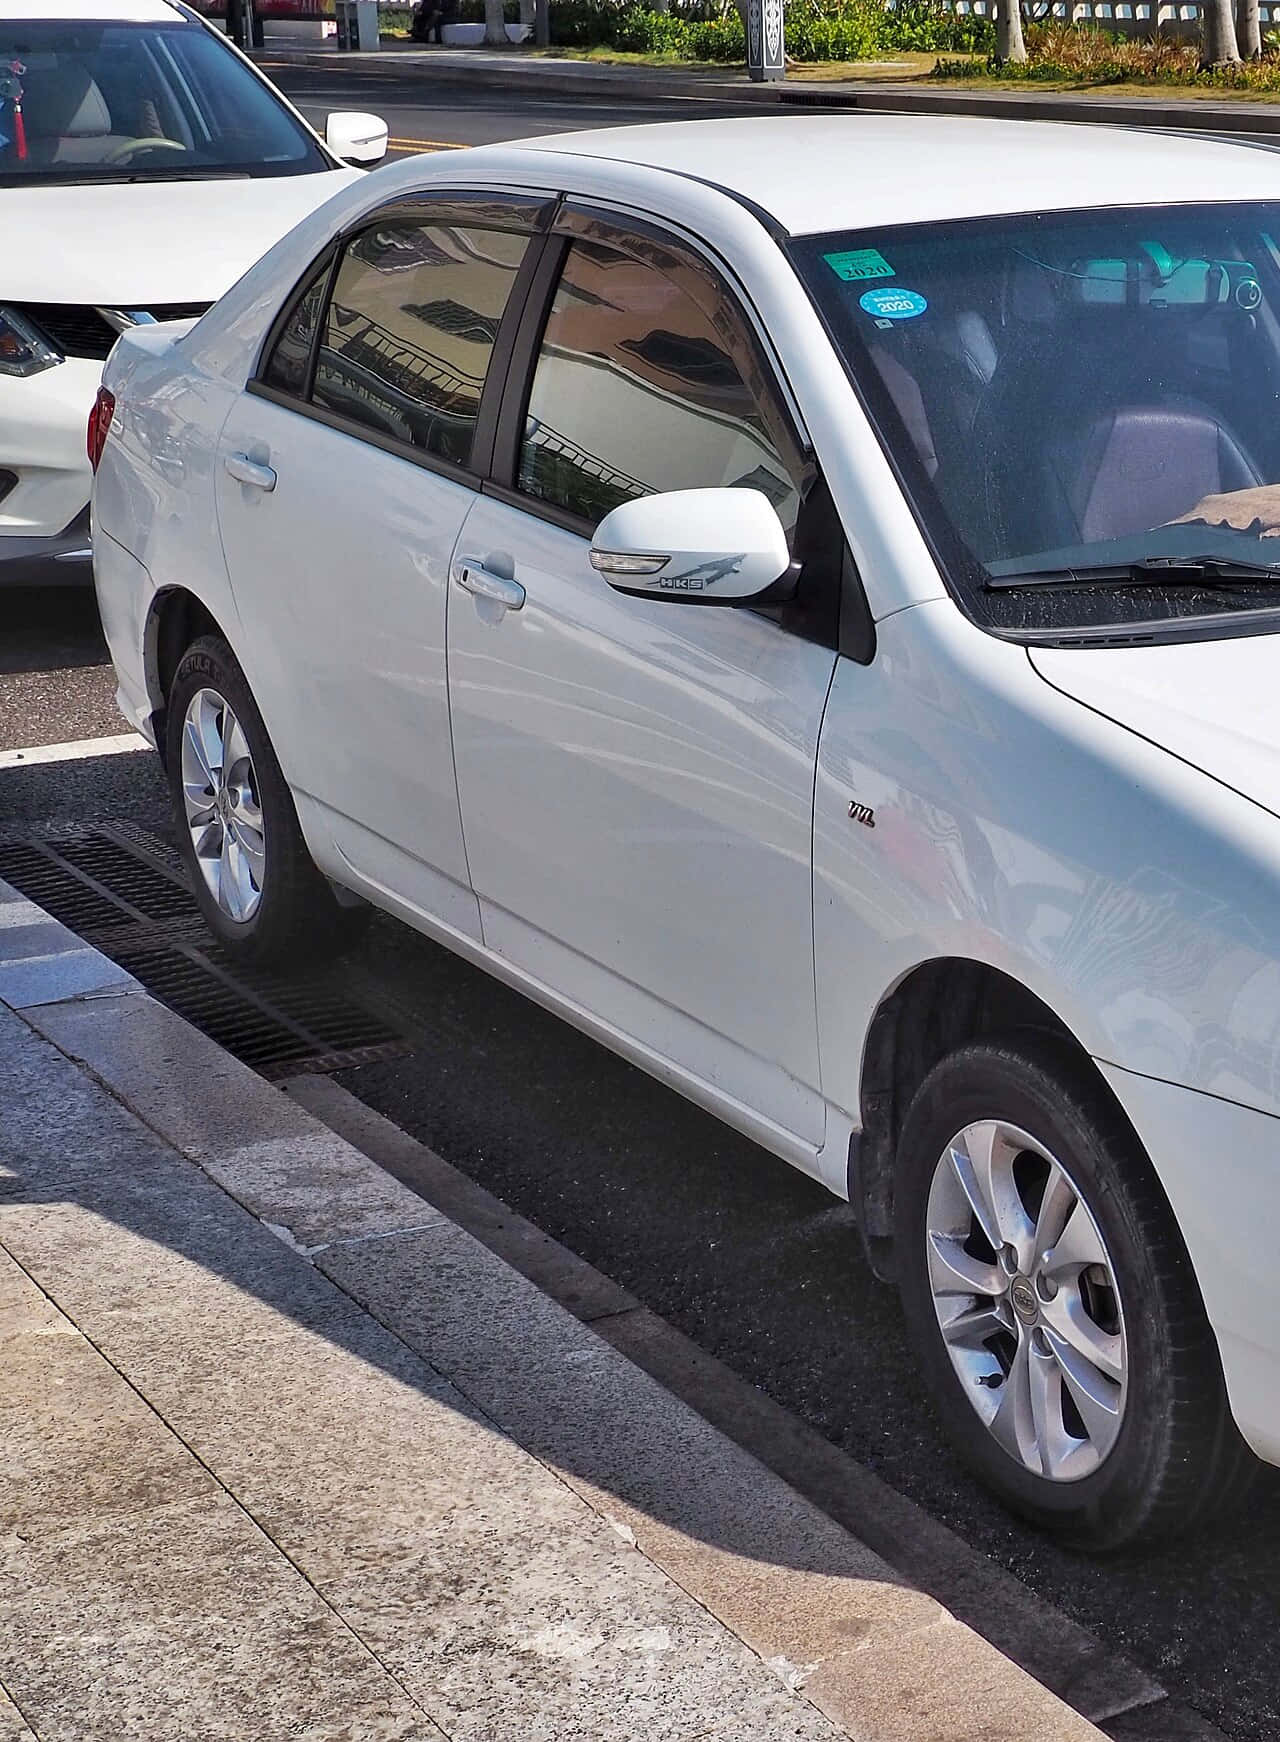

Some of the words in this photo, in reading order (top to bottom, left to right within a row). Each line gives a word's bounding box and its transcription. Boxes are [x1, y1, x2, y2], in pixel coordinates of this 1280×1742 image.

[843, 265, 888, 278] 2020
[877, 300, 914, 312] 2020
[660, 577, 704, 590] HKS
